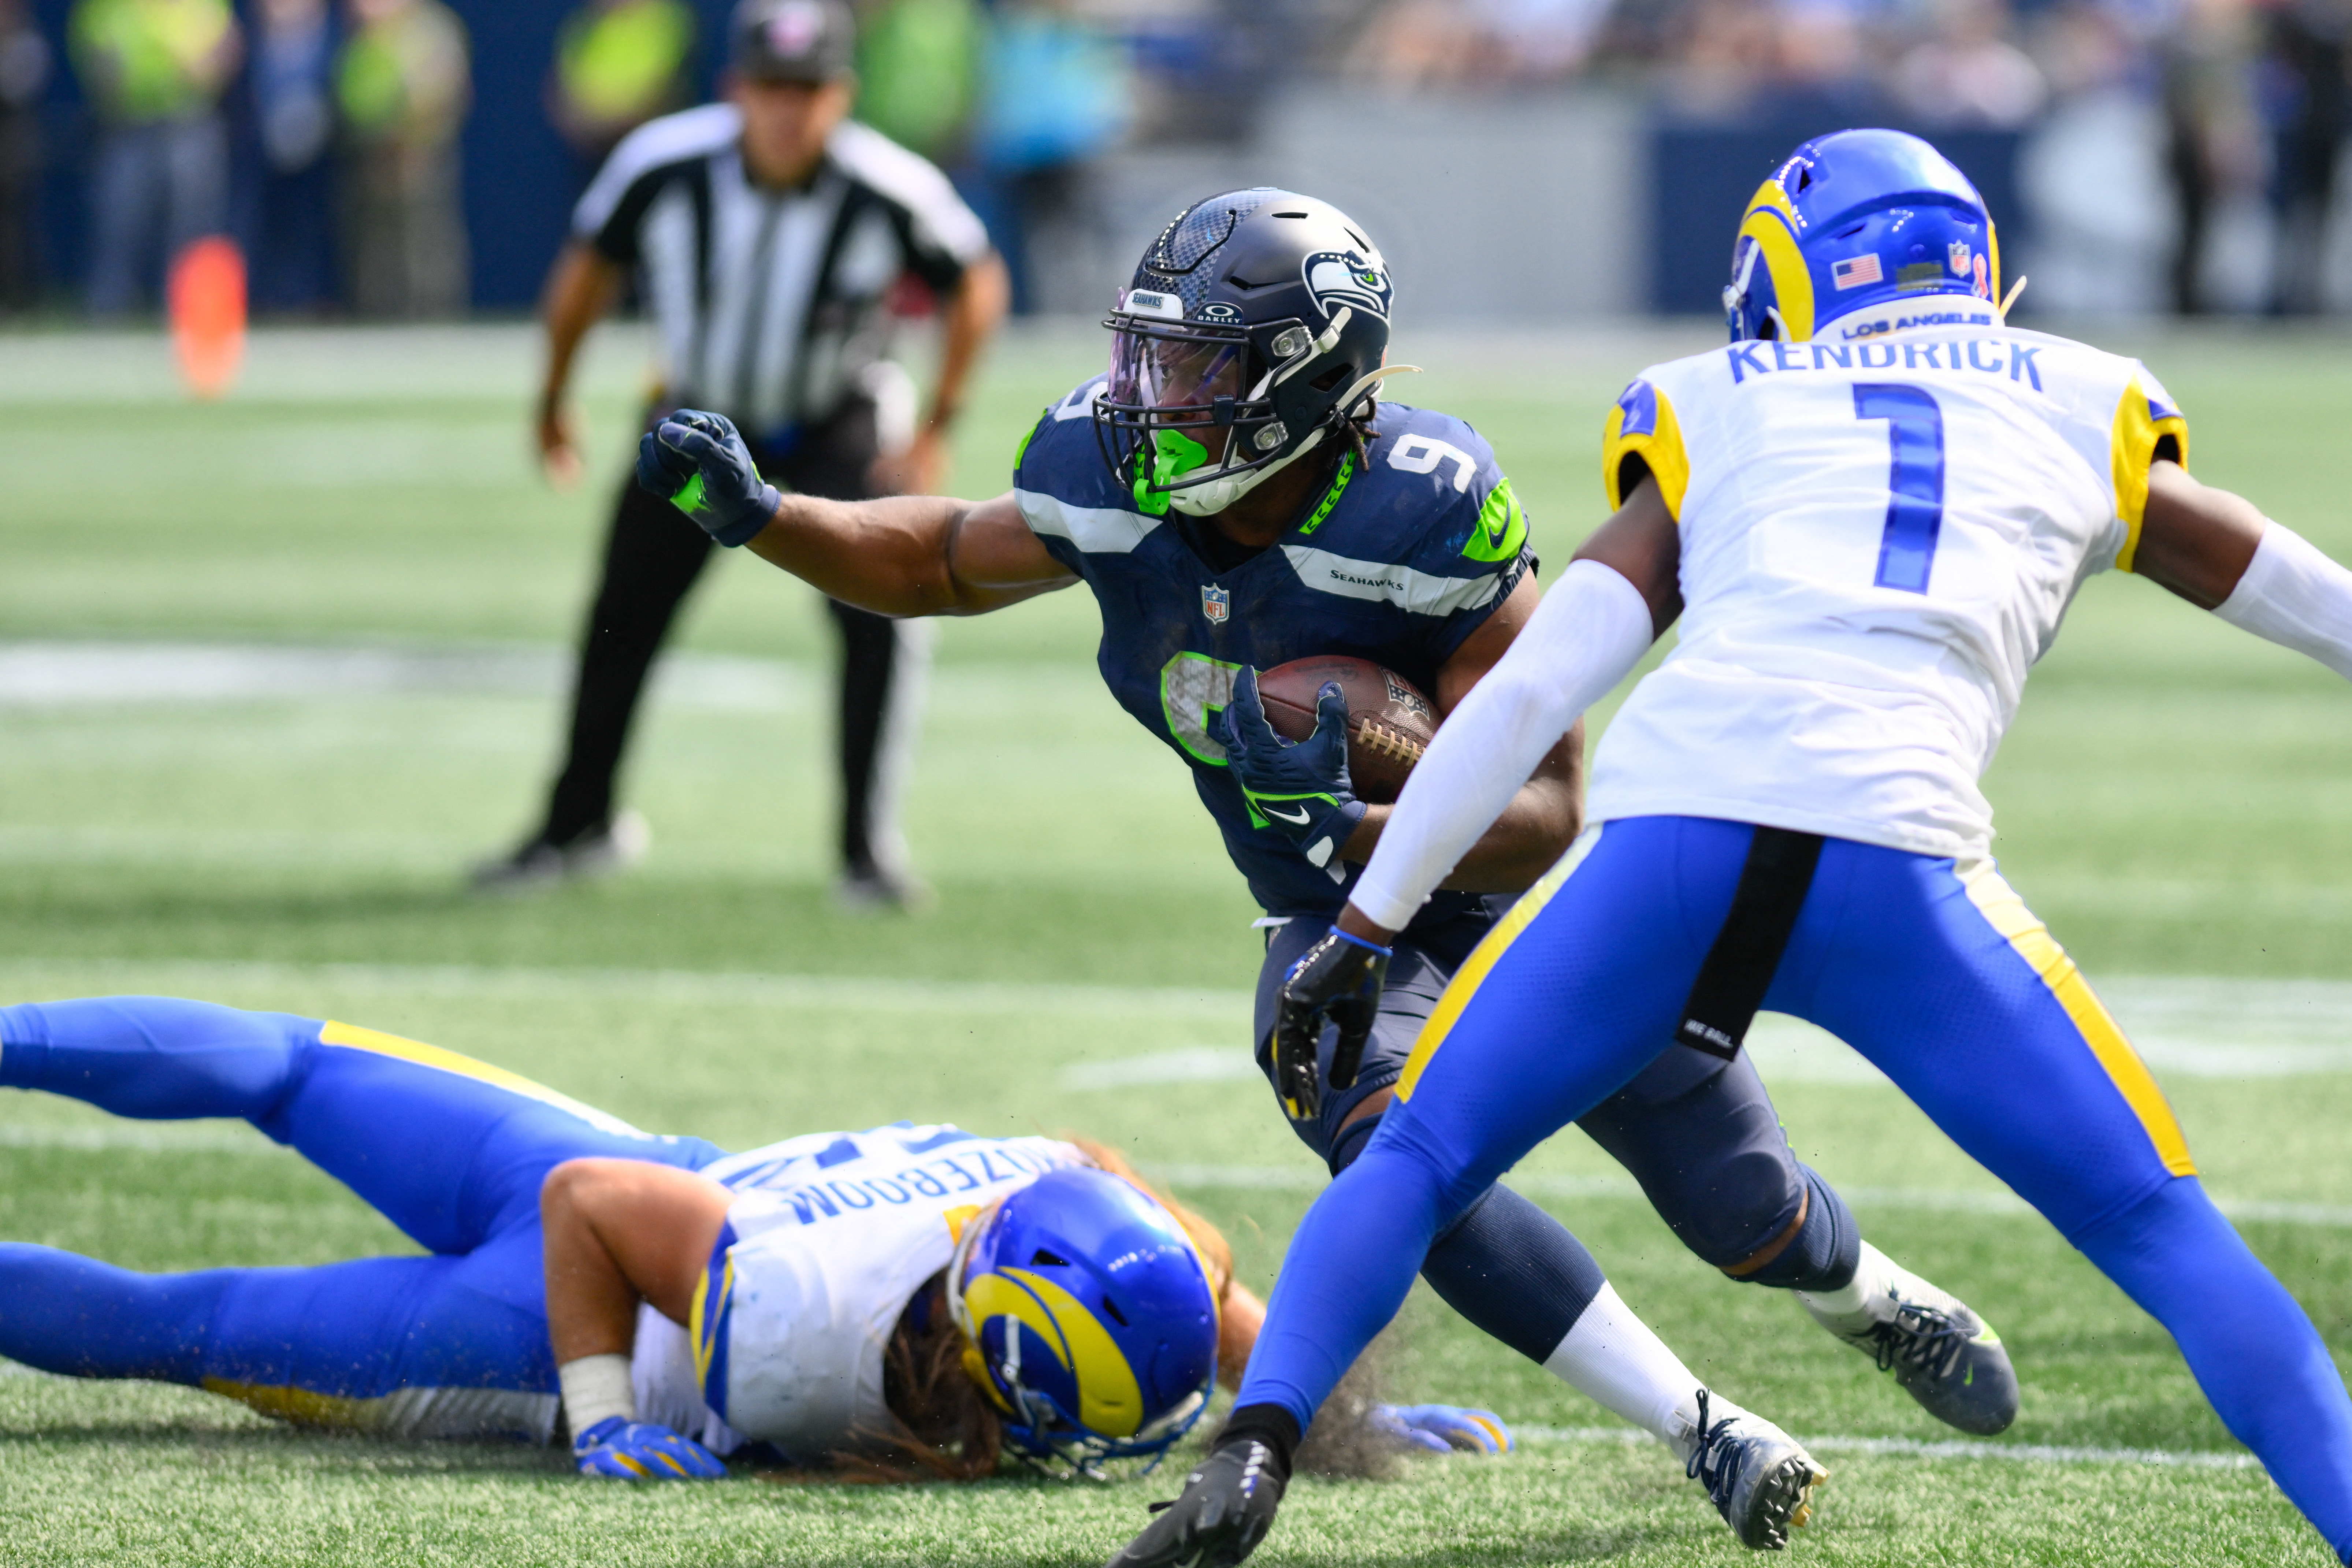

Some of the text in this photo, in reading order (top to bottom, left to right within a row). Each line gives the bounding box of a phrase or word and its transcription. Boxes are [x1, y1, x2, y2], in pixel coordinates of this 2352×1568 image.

[1132, 292, 1163, 308] SEAHAWKS
[1198, 315, 1240, 323] OAKLEY
[1842, 312, 1991, 340] LOS ANGELES
[1727, 339, 2043, 393] KENDRICK
[1386, 433, 1477, 494] 9
[1852, 383, 1946, 597] 1
[1207, 601, 1225, 617] NFL
